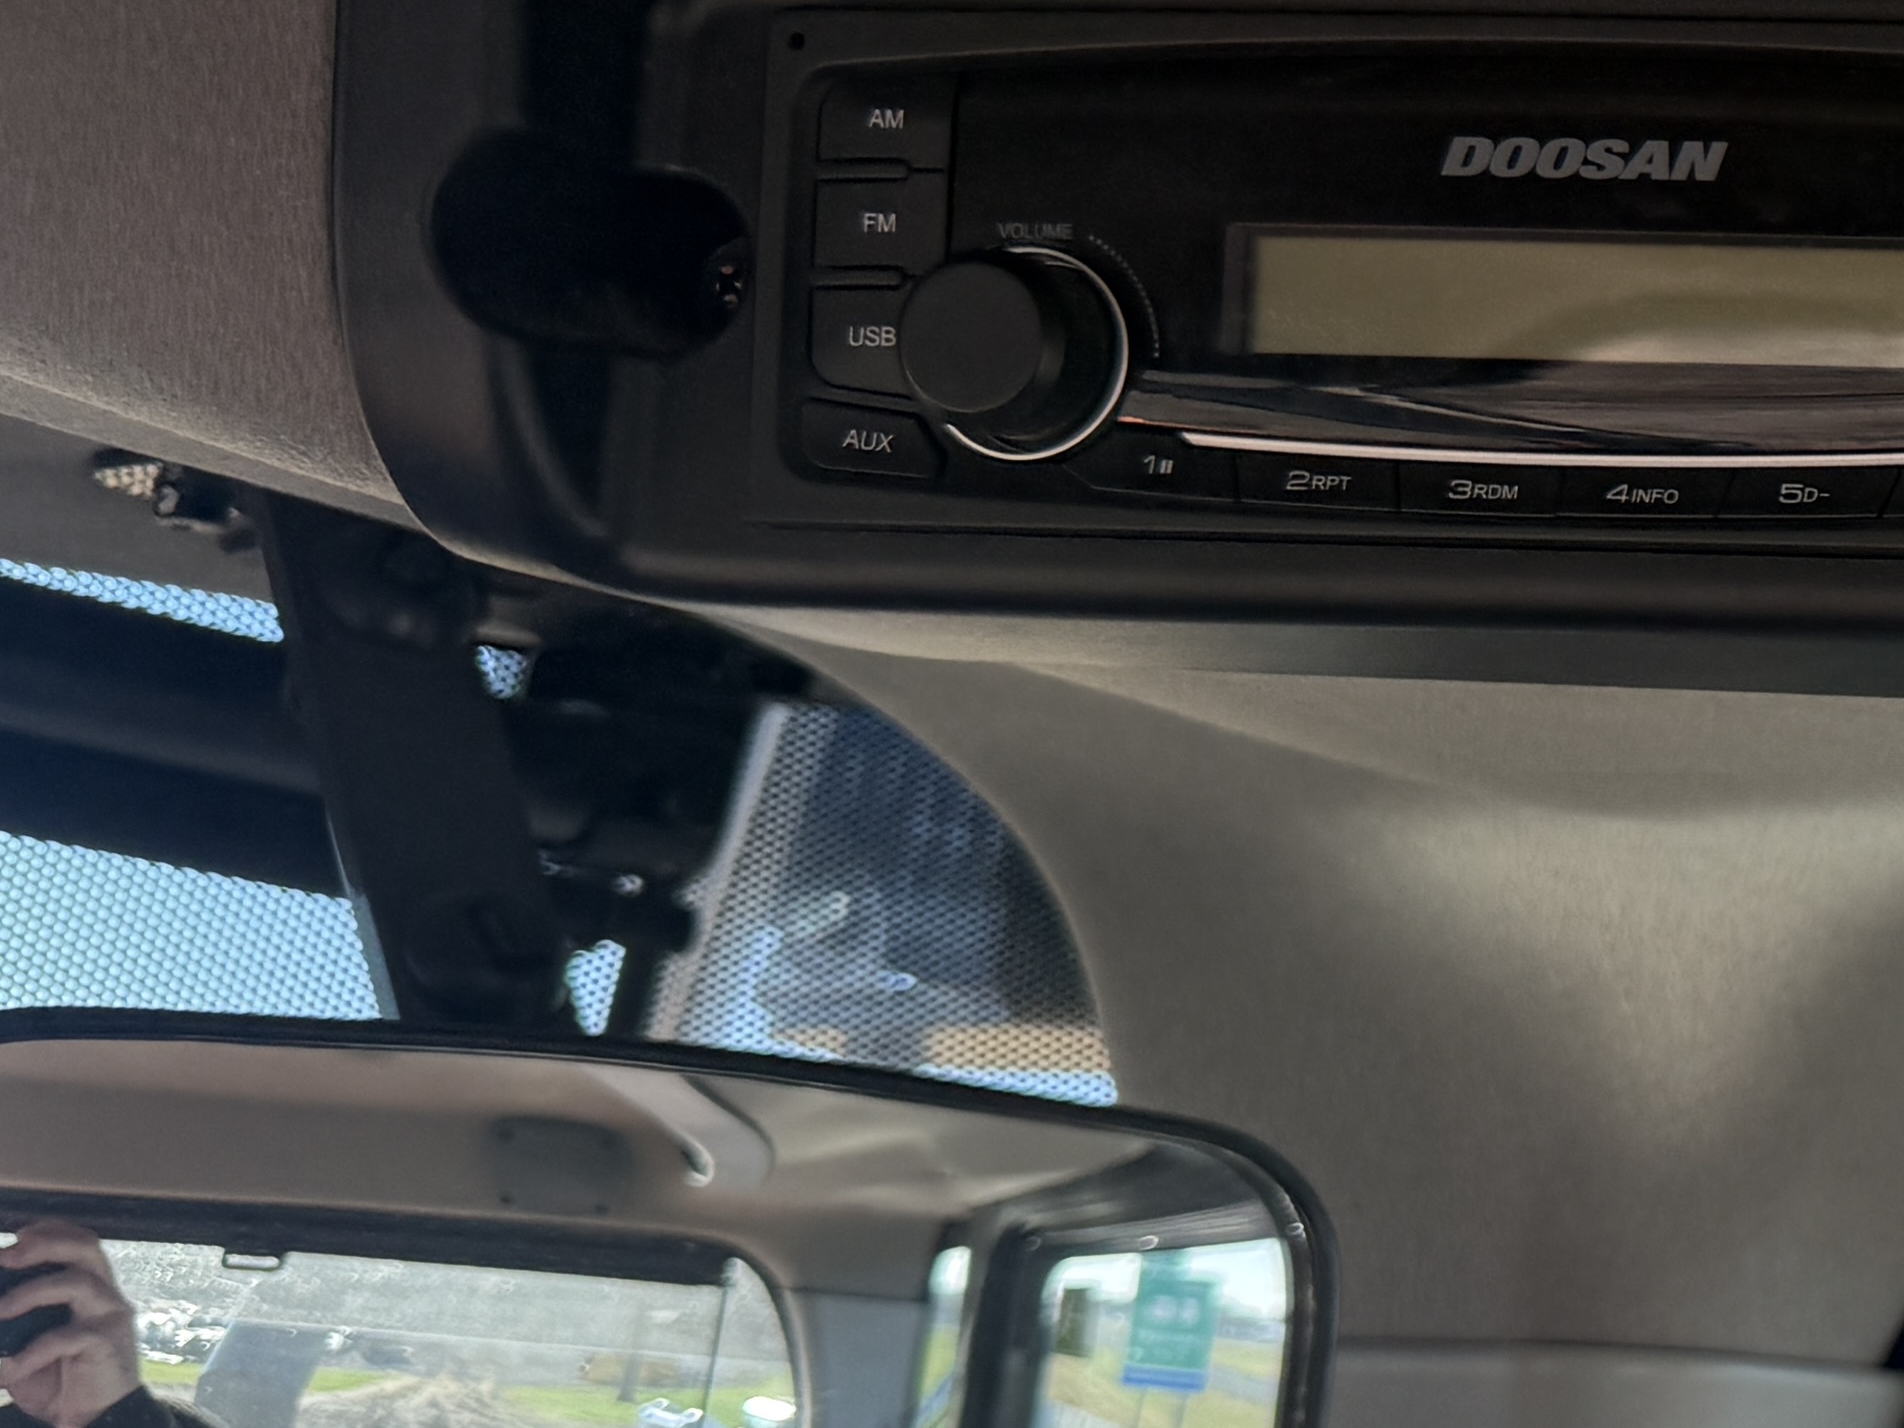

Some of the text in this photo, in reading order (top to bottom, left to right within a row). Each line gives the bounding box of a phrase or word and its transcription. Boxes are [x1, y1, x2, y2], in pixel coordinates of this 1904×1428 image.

[867, 108, 905, 129] AM
[1440, 136, 1729, 181] DOOSAN
[862, 212, 897, 233] FM
[996, 222, 1074, 240] VOLUME
[848, 325, 897, 348] USB
[841, 428, 894, 453] AUX
[1447, 479, 1519, 500] 3RDM
